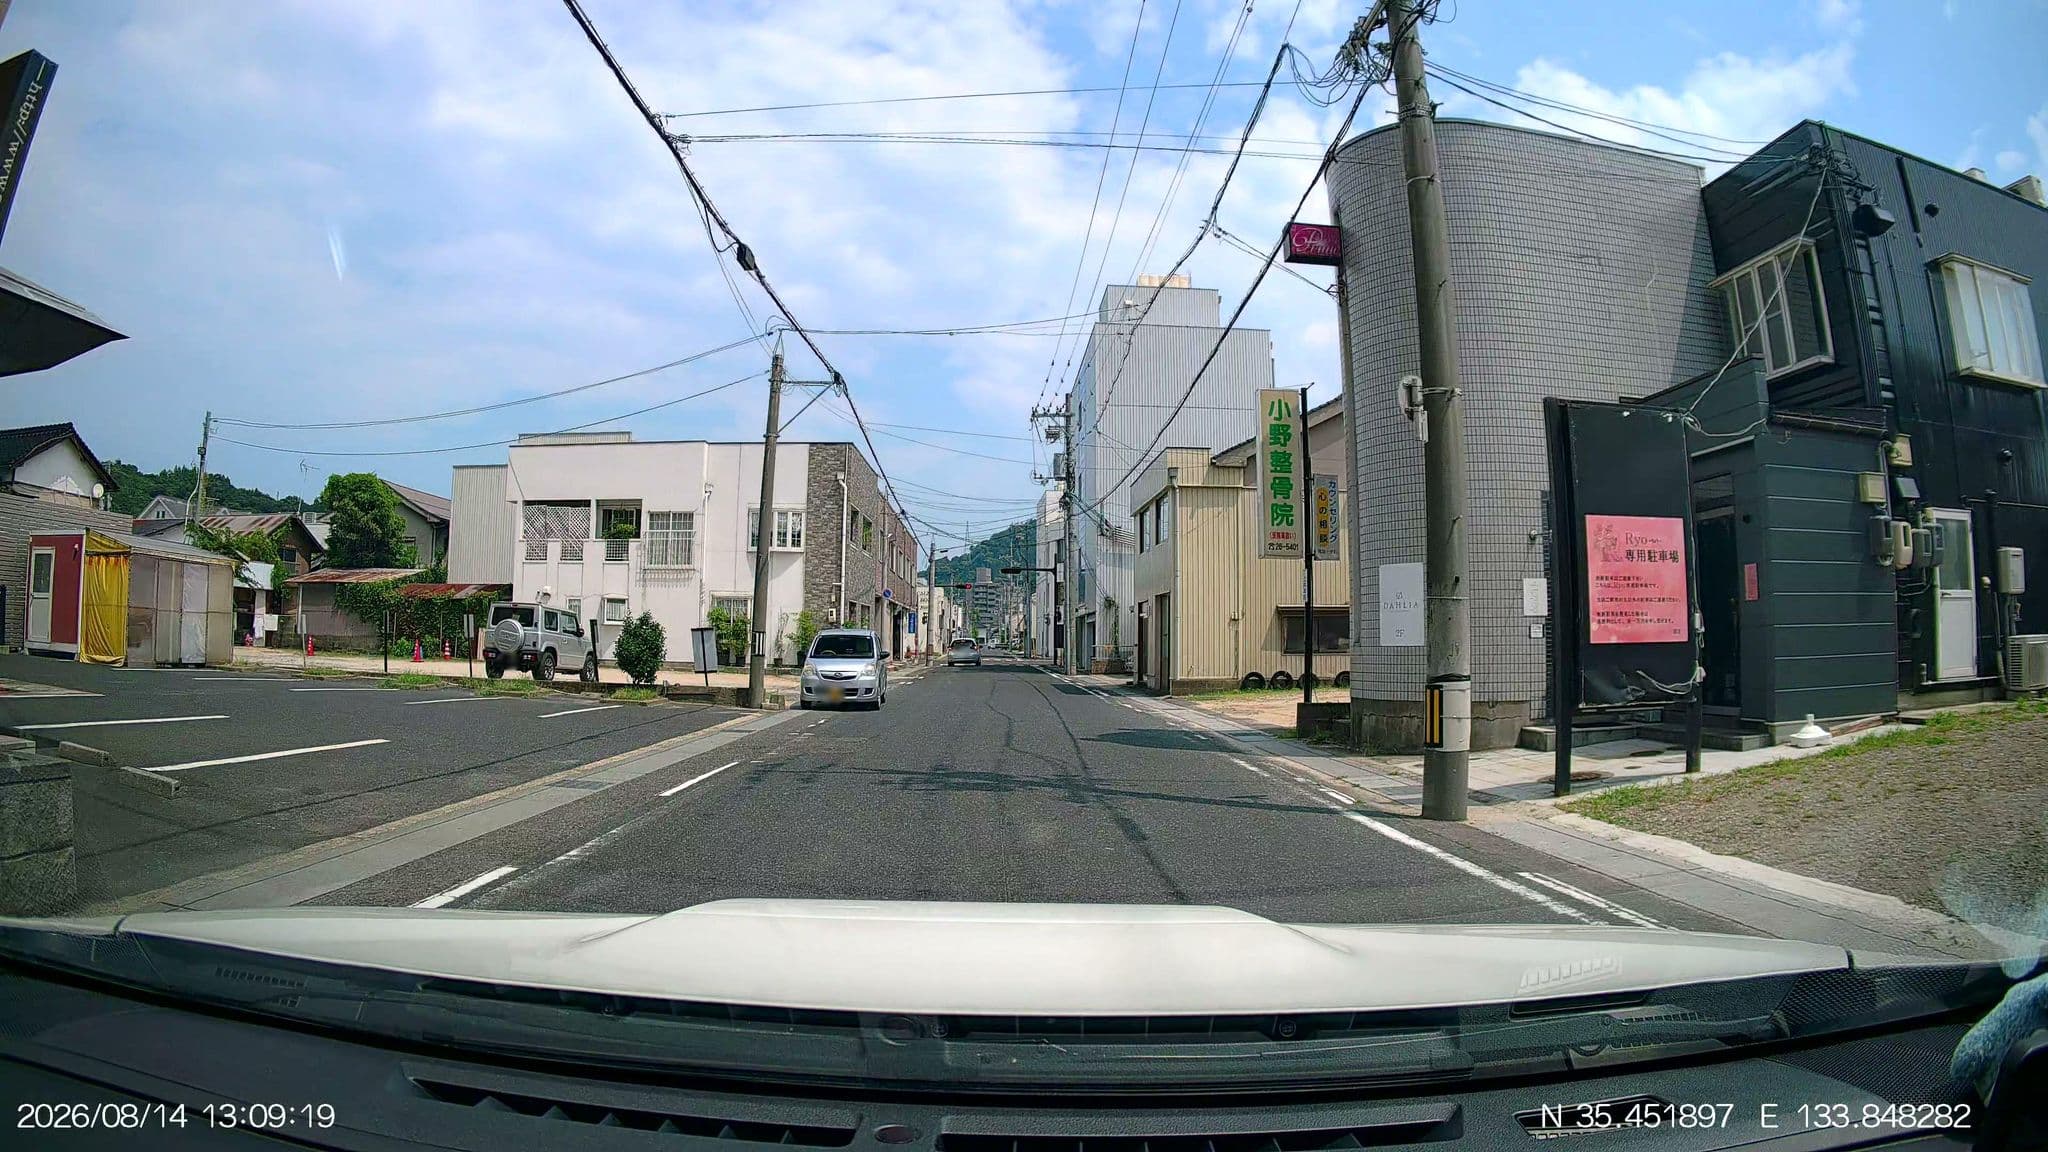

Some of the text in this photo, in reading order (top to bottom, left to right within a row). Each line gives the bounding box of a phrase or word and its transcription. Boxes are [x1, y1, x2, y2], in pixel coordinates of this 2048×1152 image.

[1268, 398, 1295, 528] 小野整骨院
[1327, 481, 1338, 544] カウンセリング
[1625, 549, 1680, 563] 専用駐車場
[1383, 601, 1418, 610] DAHLIA
